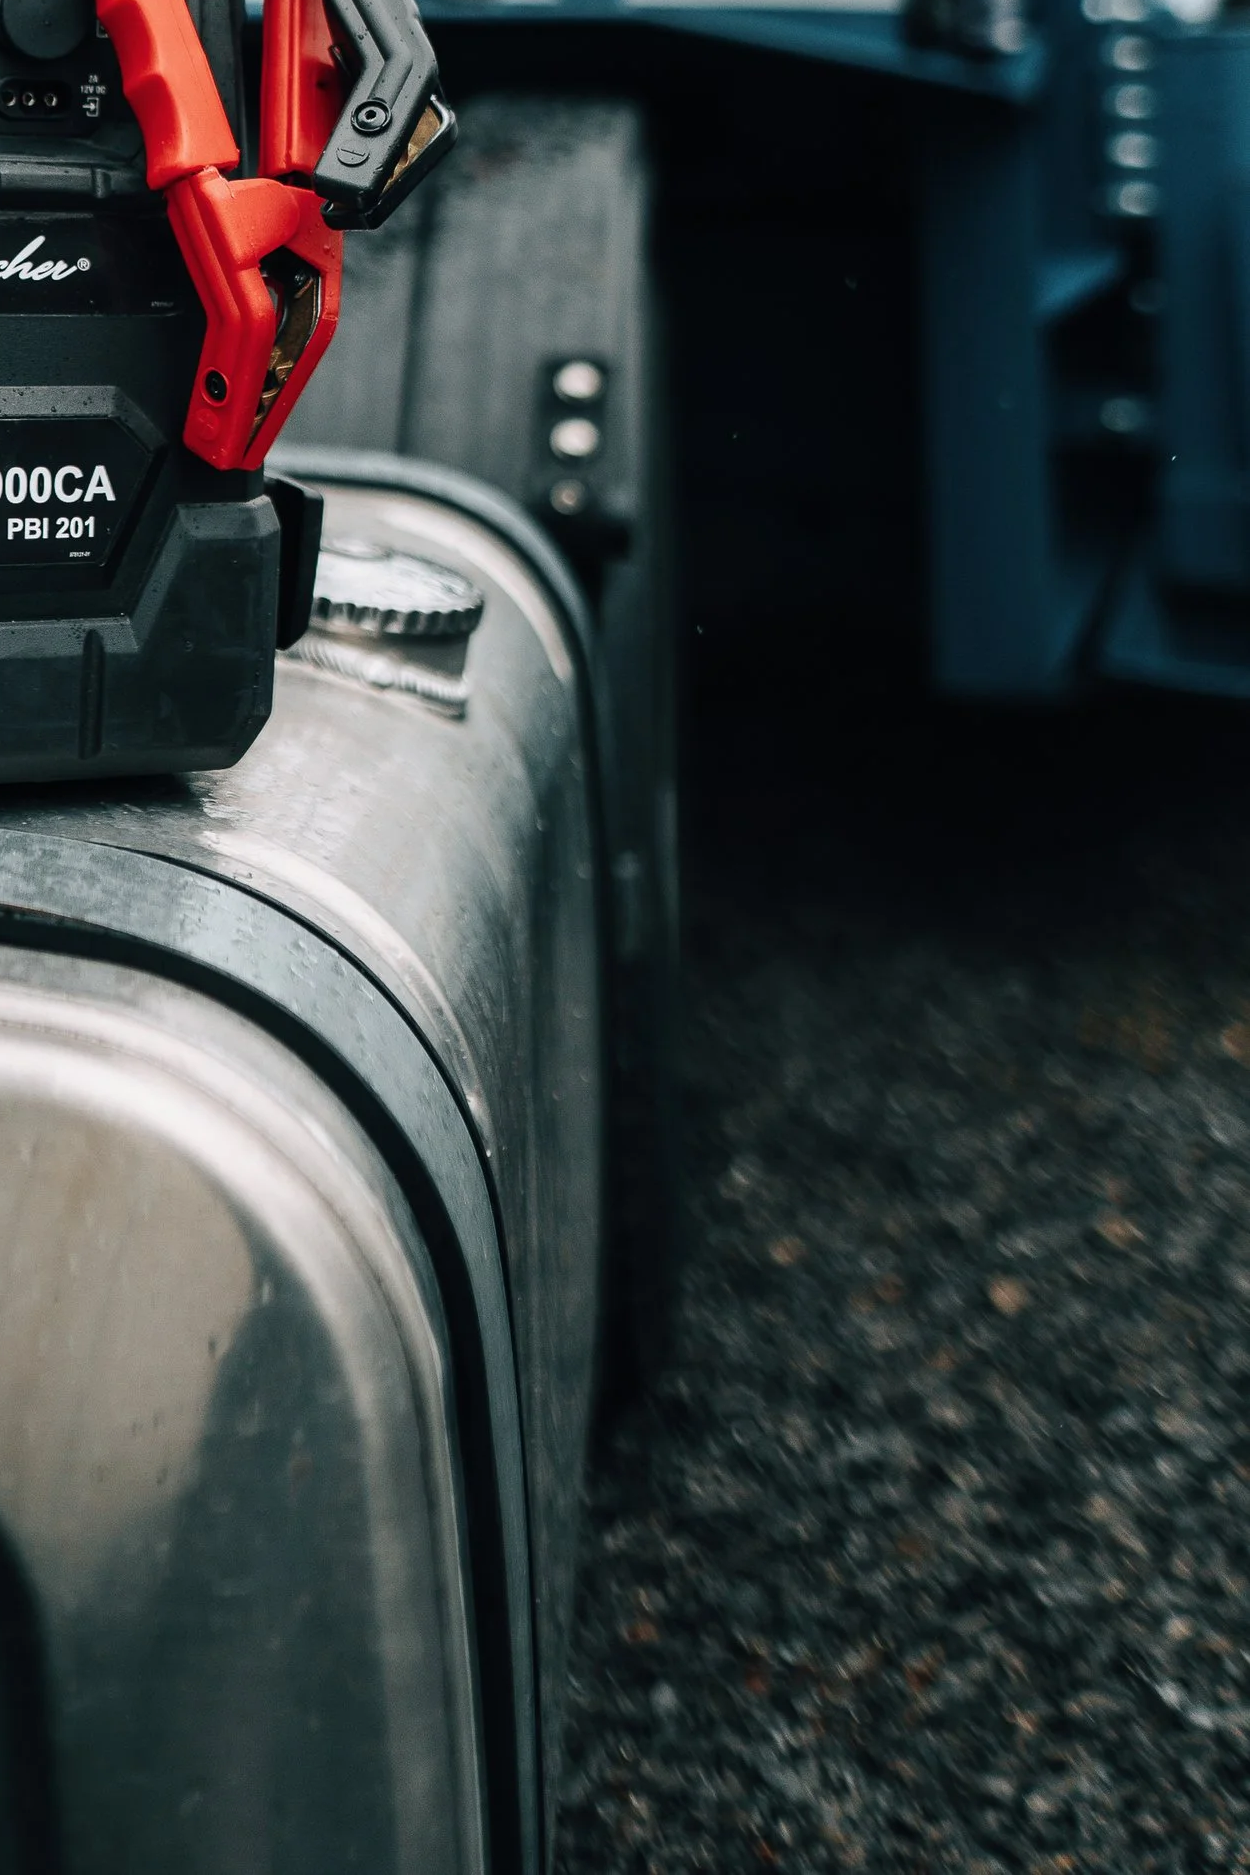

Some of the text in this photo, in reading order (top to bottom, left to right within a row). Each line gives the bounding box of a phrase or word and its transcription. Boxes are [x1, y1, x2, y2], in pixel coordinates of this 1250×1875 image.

[80, 85, 94, 94] 12V
[6, 516, 96, 540] PBI 201
